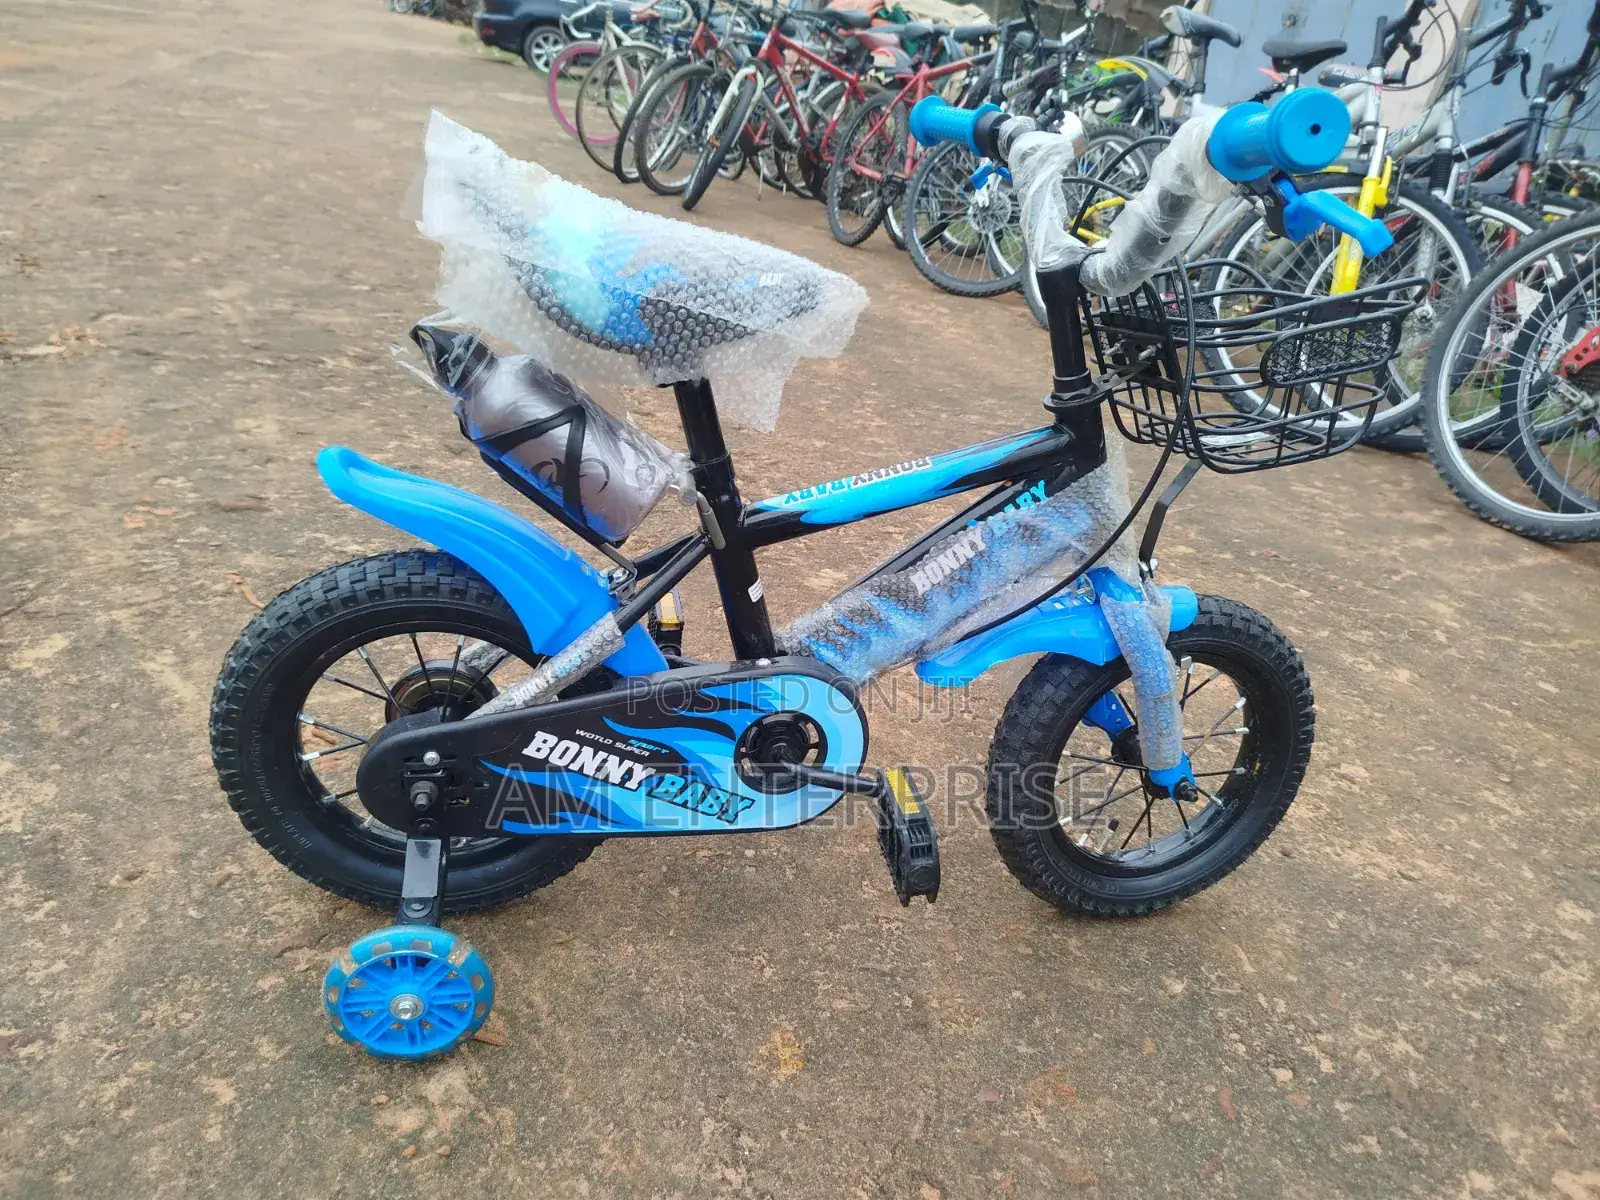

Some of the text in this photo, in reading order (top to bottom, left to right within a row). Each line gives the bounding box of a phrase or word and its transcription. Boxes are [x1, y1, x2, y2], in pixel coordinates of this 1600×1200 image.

[909, 528, 986, 596] BONNY
[521, 730, 755, 824] BONNY BABY
[575, 729, 651, 757] WOTLD SUPER
